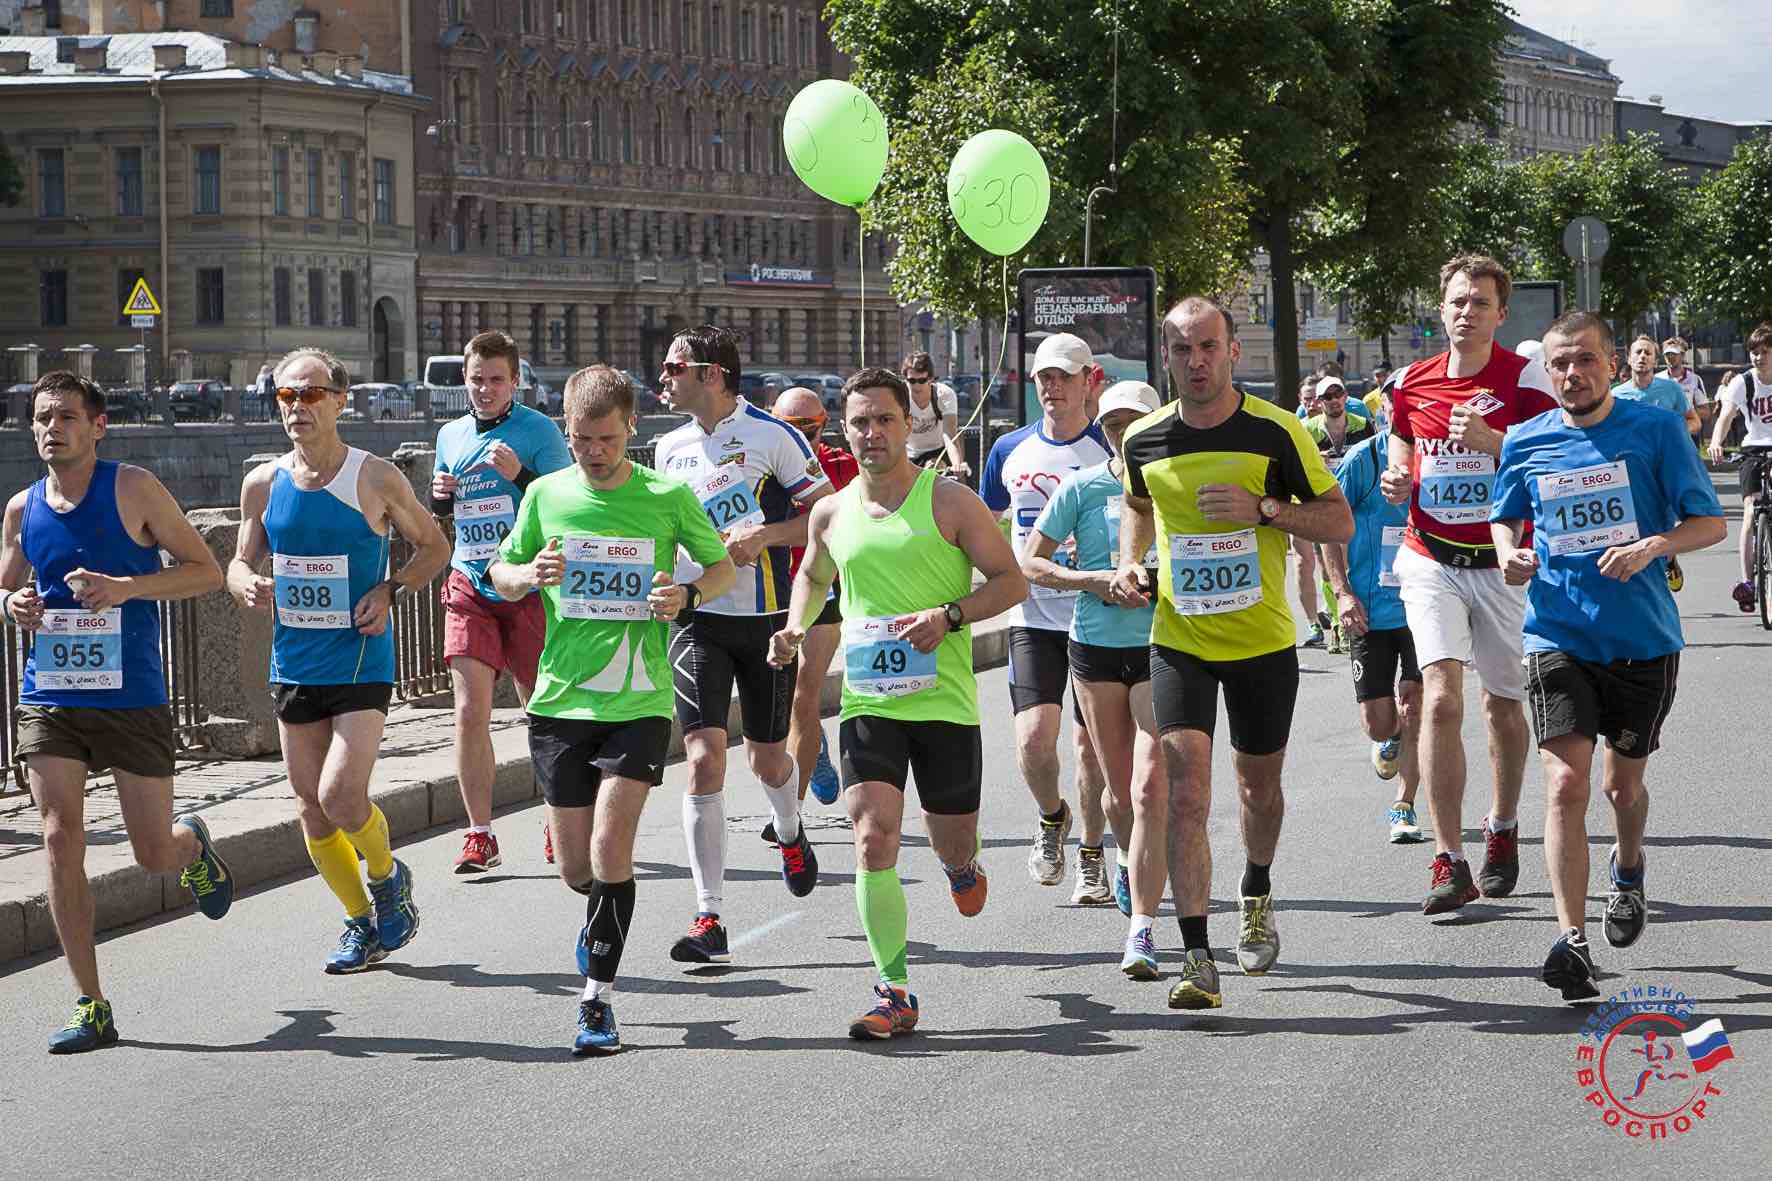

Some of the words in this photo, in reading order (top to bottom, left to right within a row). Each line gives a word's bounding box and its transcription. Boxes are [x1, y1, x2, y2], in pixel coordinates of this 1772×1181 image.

[1034, 302, 1127, 314] НЕЗАБЫВАЕМЫЙ
[1034, 314, 1075, 326] ОТДЫХ
[1455, 461, 1481, 470] ERGO
[706, 474, 729, 491] ERGO
[1582, 472, 1612, 486] ERGO
[1429, 482, 1489, 505] 1429
[478, 502, 501, 512] ERGO
[1555, 496, 1624, 531] 1586
[461, 520, 508, 544] 3080
[607, 546, 638, 556] ERGO
[1211, 539, 1242, 551] ERGO
[306, 563, 334, 572] ERGO
[569, 570, 642, 597] 2549
[1180, 563, 1251, 592] 2302
[287, 584, 332, 608] 398
[76, 618, 106, 627] ERGO
[887, 623, 908, 633] ERG
[53, 643, 105, 668] 955
[872, 649, 906, 674] 49
